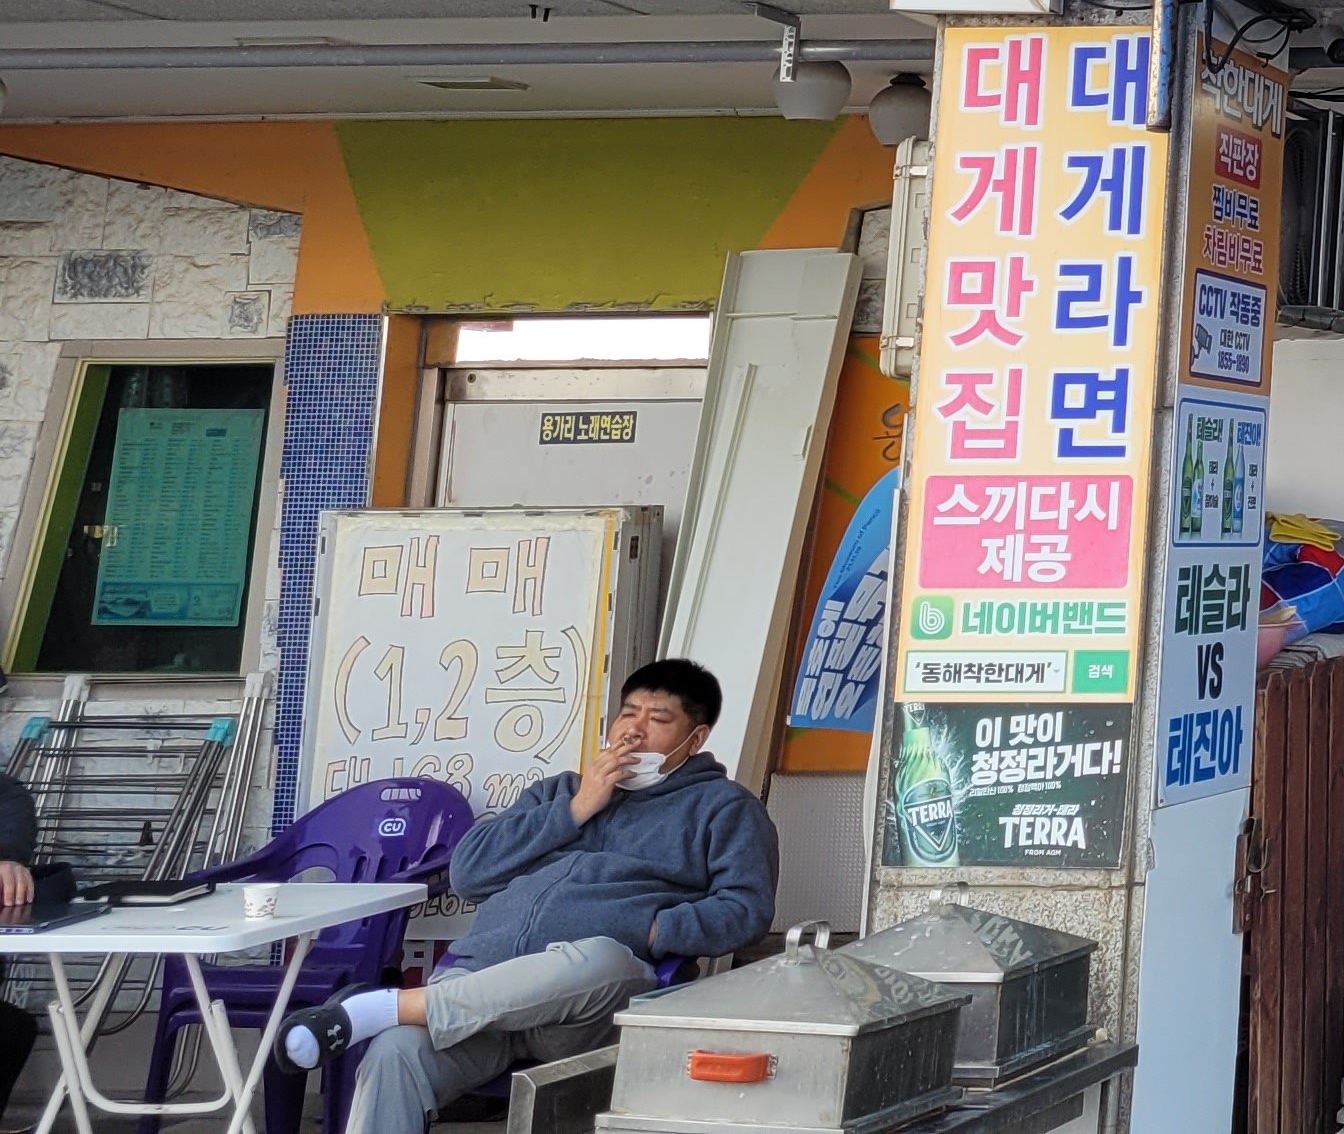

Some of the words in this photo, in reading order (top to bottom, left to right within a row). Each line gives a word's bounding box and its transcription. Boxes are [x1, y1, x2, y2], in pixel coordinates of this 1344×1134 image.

[1201, 47, 1284, 139] 착한대게
[1219, 133, 1259, 182] 직판장
[1212, 184, 1260, 231] 찜비무료
[1202, 224, 1264, 276] 차림비무료
[1199, 283, 1228, 320] CCTV
[1229, 290, 1262, 328] 작동중
[1234, 330, 1251, 352] CCTV
[542, 415, 576, 441] 용가리
[577, 414, 634, 441] 노래연습장
[933, 480, 1120, 531] 스끼다시
[977, 534, 1072, 584] 제공
[961, 601, 1128, 636] 네이버밴드
[1174, 564, 1252, 637] 테슬라
[334, 625, 588, 764] (1,2층)
[1088, 663, 1114, 680] 검색
[1197, 643, 1225, 700] VS
[975, 717, 1002, 748] 이
[1008, 711, 1064, 747] 맛이
[1165, 704, 1244, 788] 테진아
[970, 739, 1123, 786] 청정라거다!
[907, 799, 953, 827] TERRA
[999, 816, 1087, 849] TERRA
[1024, 848, 1044, 856] FROM
